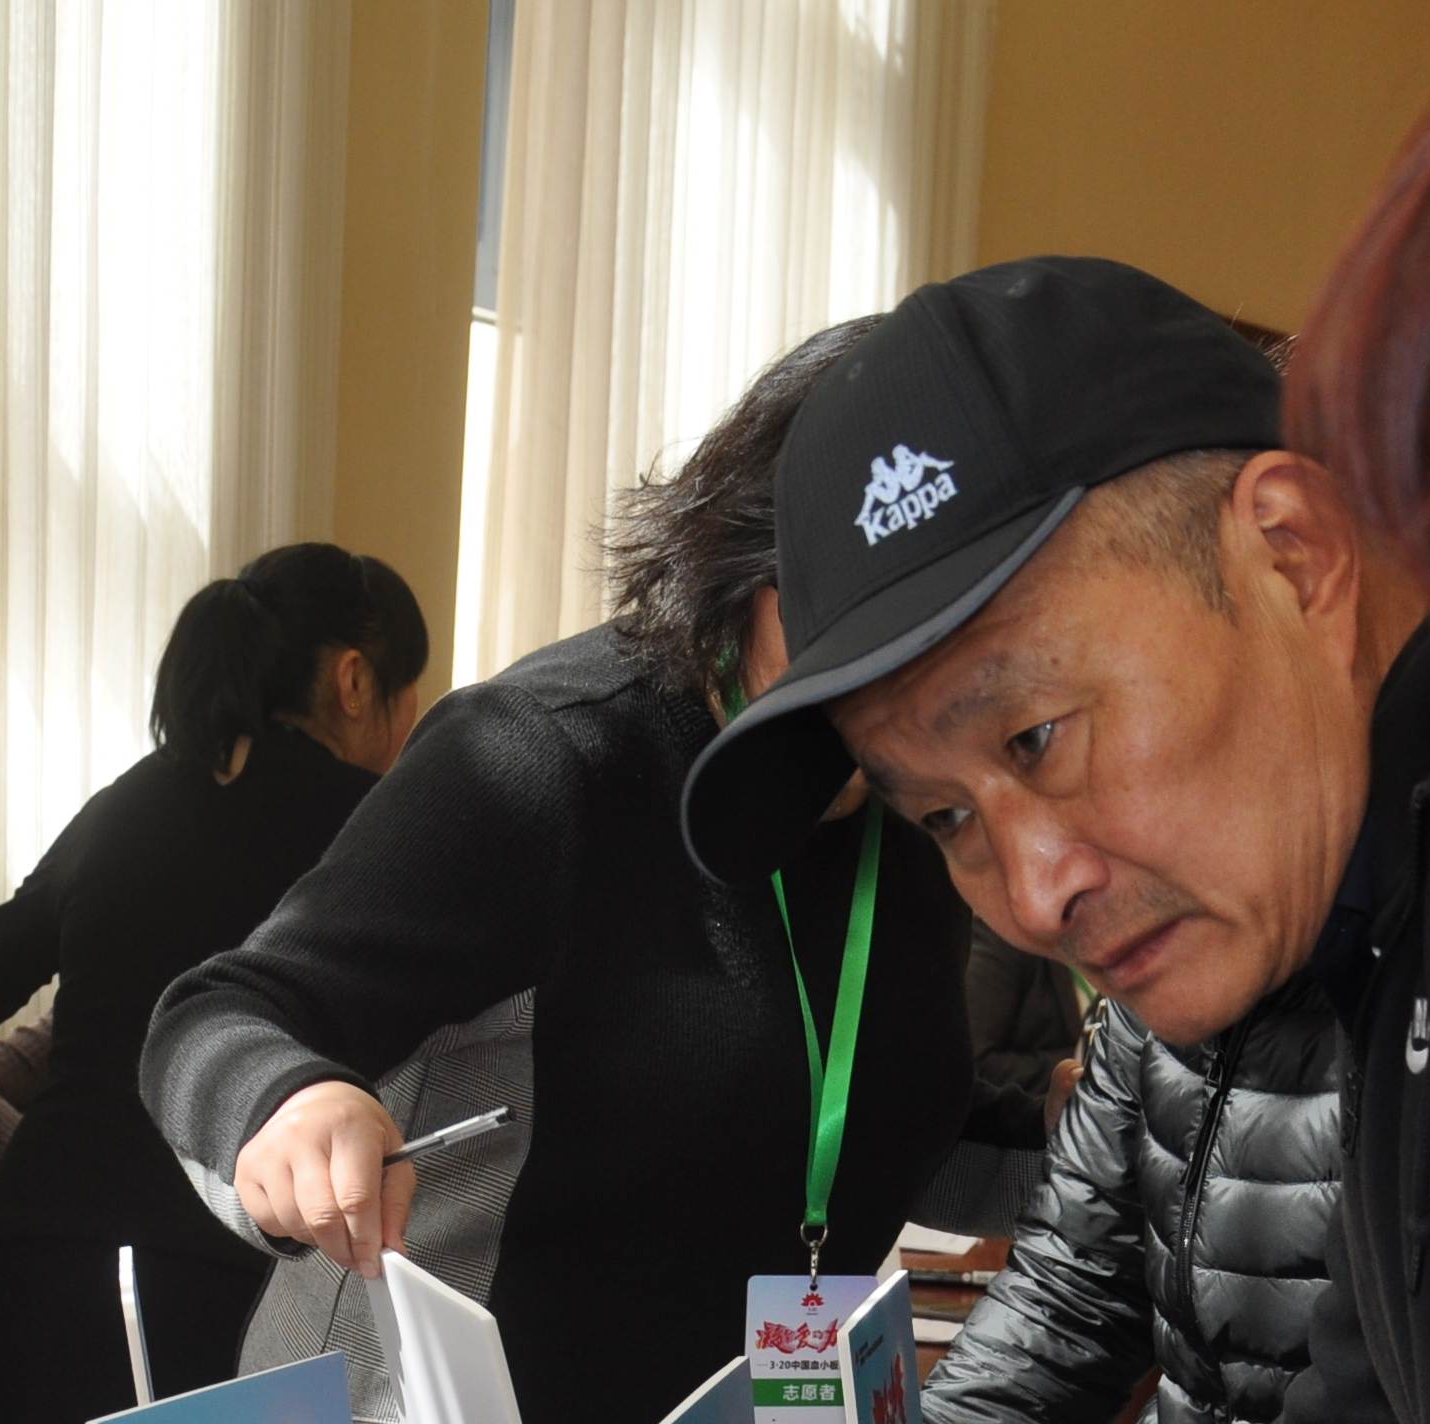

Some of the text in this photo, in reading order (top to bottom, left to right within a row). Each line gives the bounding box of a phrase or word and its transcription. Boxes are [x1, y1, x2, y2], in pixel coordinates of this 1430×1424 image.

[861, 472, 958, 546] Kappa
[770, 1360, 840, 1371] 3·20中国血小板
[782, 1384, 836, 1402] 志愿者
